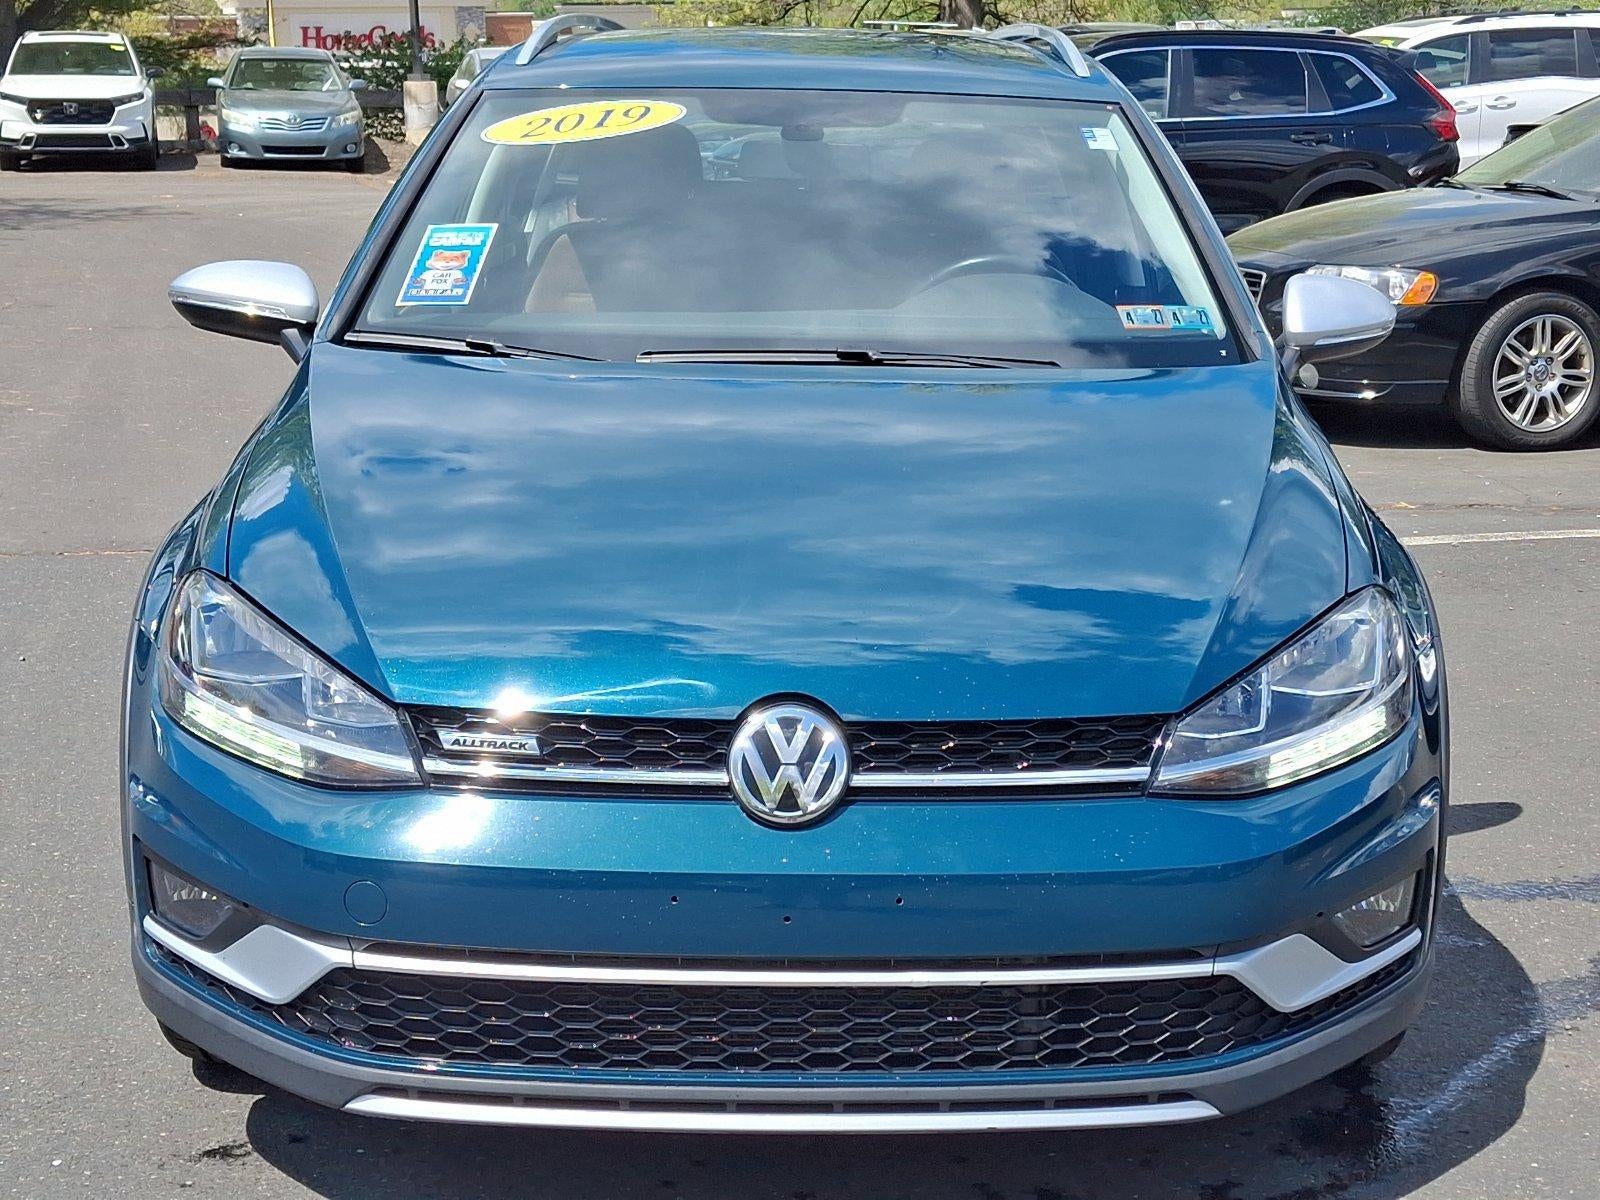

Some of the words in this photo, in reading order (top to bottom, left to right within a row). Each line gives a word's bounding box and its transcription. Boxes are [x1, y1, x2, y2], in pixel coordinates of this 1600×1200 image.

[300, 26, 435, 50] HomeGs
[520, 105, 651, 138] 2019
[451, 738, 529, 751] ALLTRACK
[732, 707, 844, 818] VW
